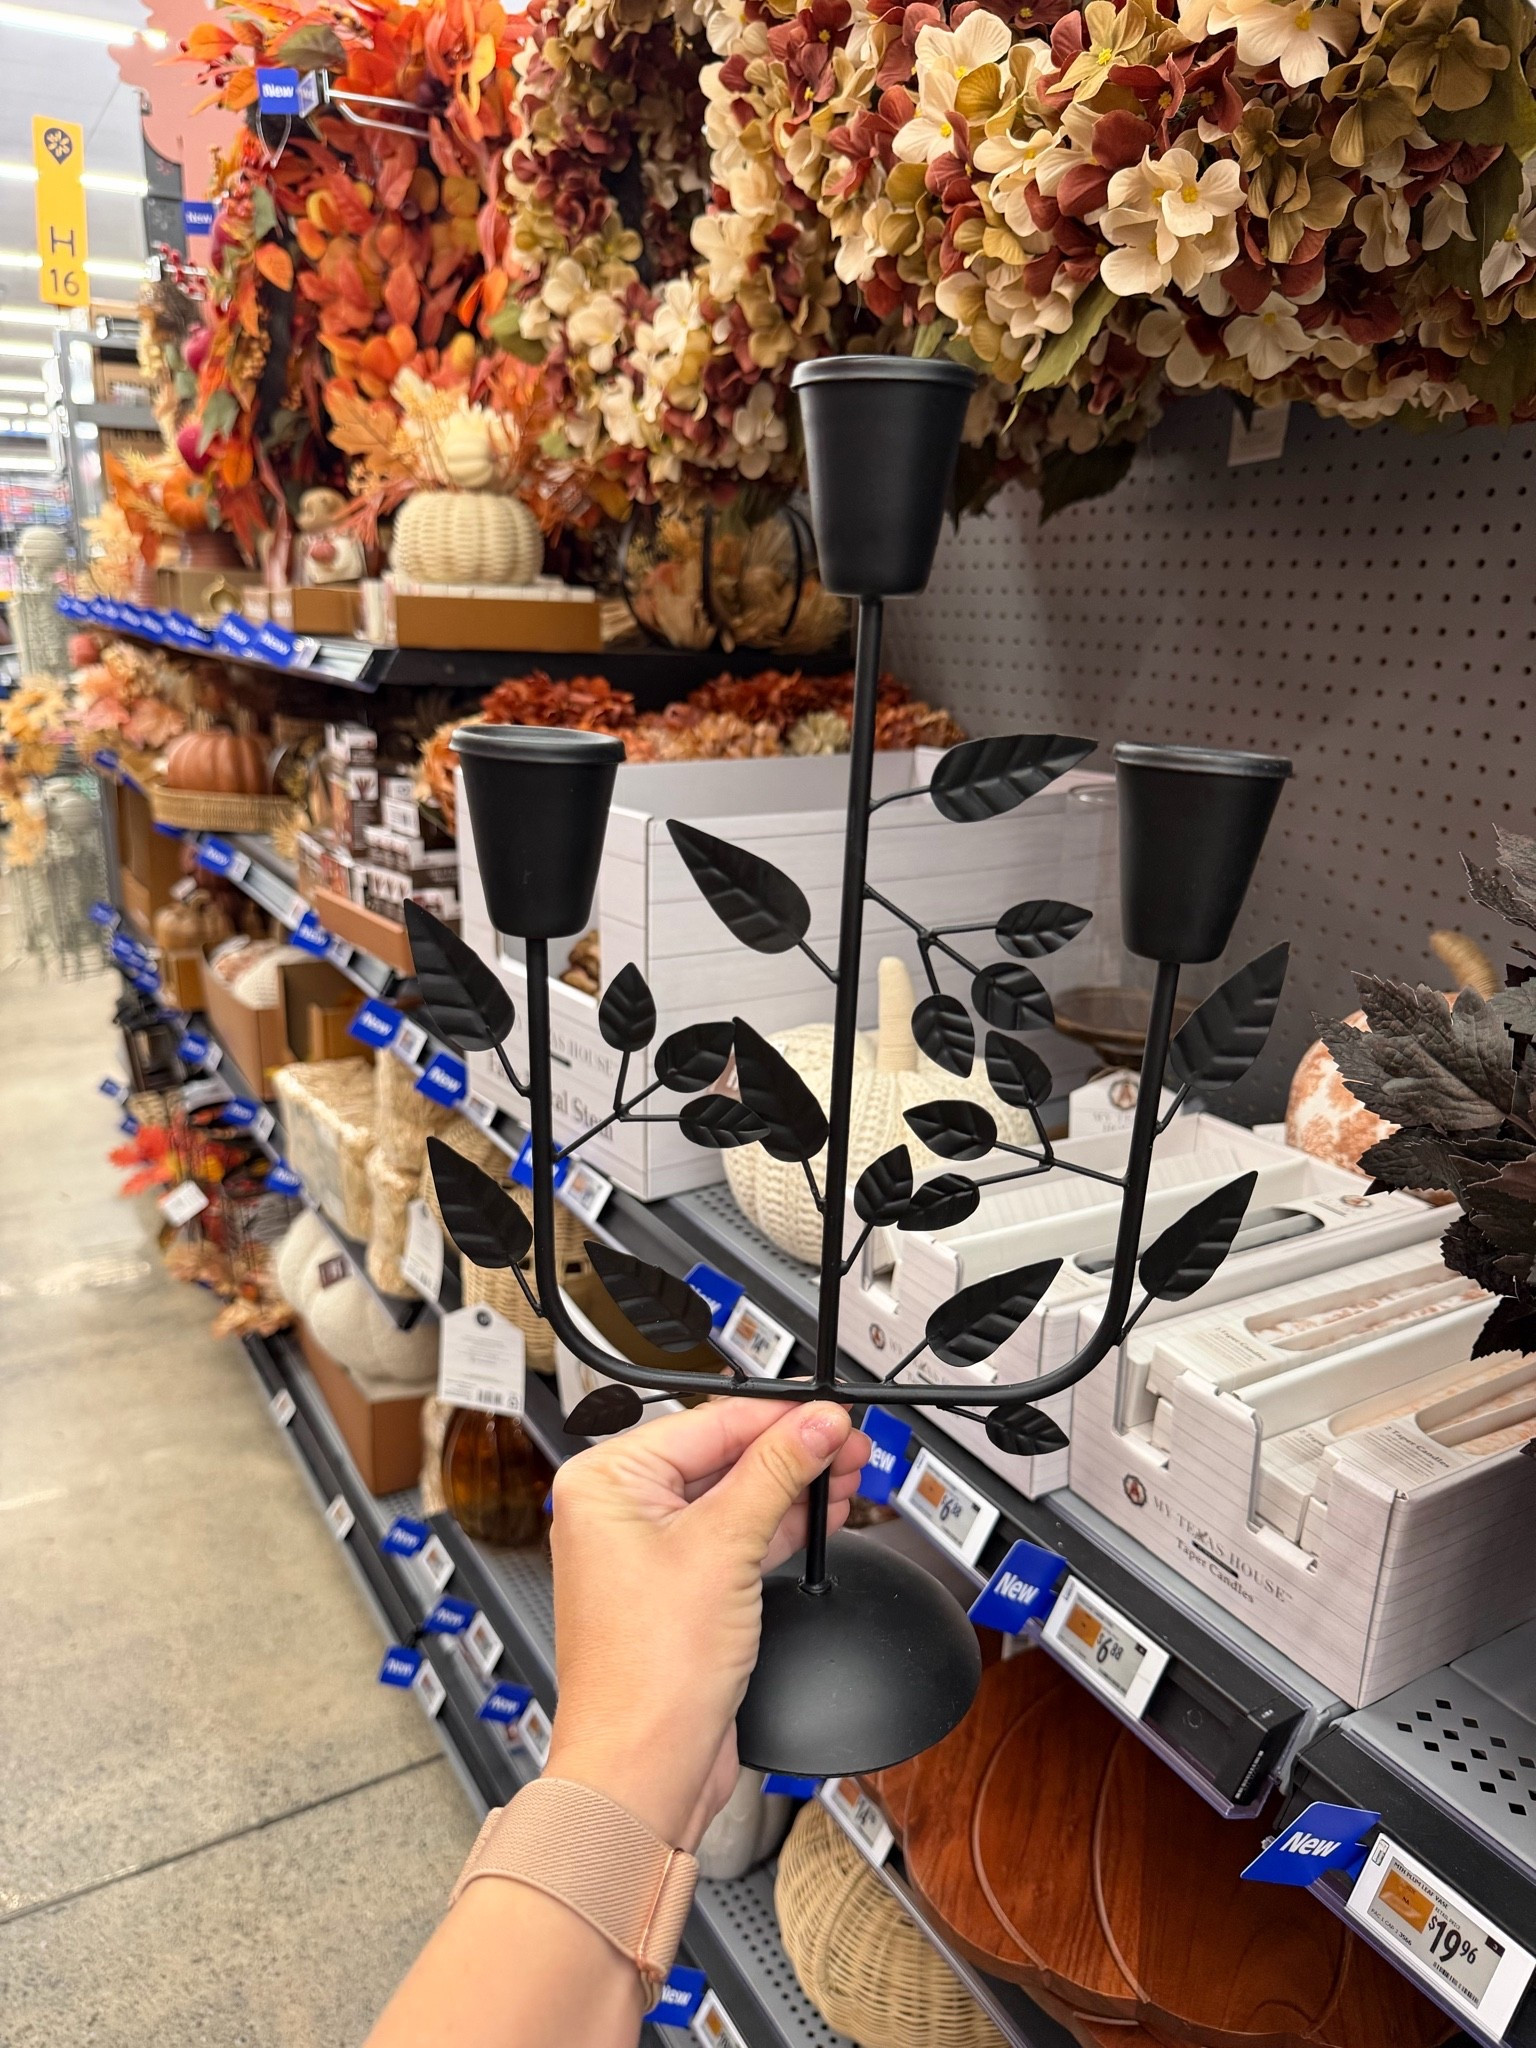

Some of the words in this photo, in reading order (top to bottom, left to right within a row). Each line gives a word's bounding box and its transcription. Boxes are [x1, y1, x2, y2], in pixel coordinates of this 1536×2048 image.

[262, 83, 294, 98] New
[50, 225, 75, 257] H
[50, 268, 80, 297] 16
[360, 1010, 393, 1037] New
[427, 1065, 462, 1094] New
[1415, 1444, 1450, 1468] Candles
[1153, 1495, 1171, 1518] MY
[1176, 1512, 1225, 1557] TEXAS
[1175, 1536, 1208, 1568] Taper
[1208, 1563, 1255, 1604] Candles
[993, 1571, 1040, 1606] New
[1279, 1831, 1342, 1858] New
[1405, 1871, 1421, 1887] PLUM
[1420, 1883, 1434, 1897] LEAF
[1434, 1895, 1448, 1909] VASE
[662, 1984, 692, 2007] New
